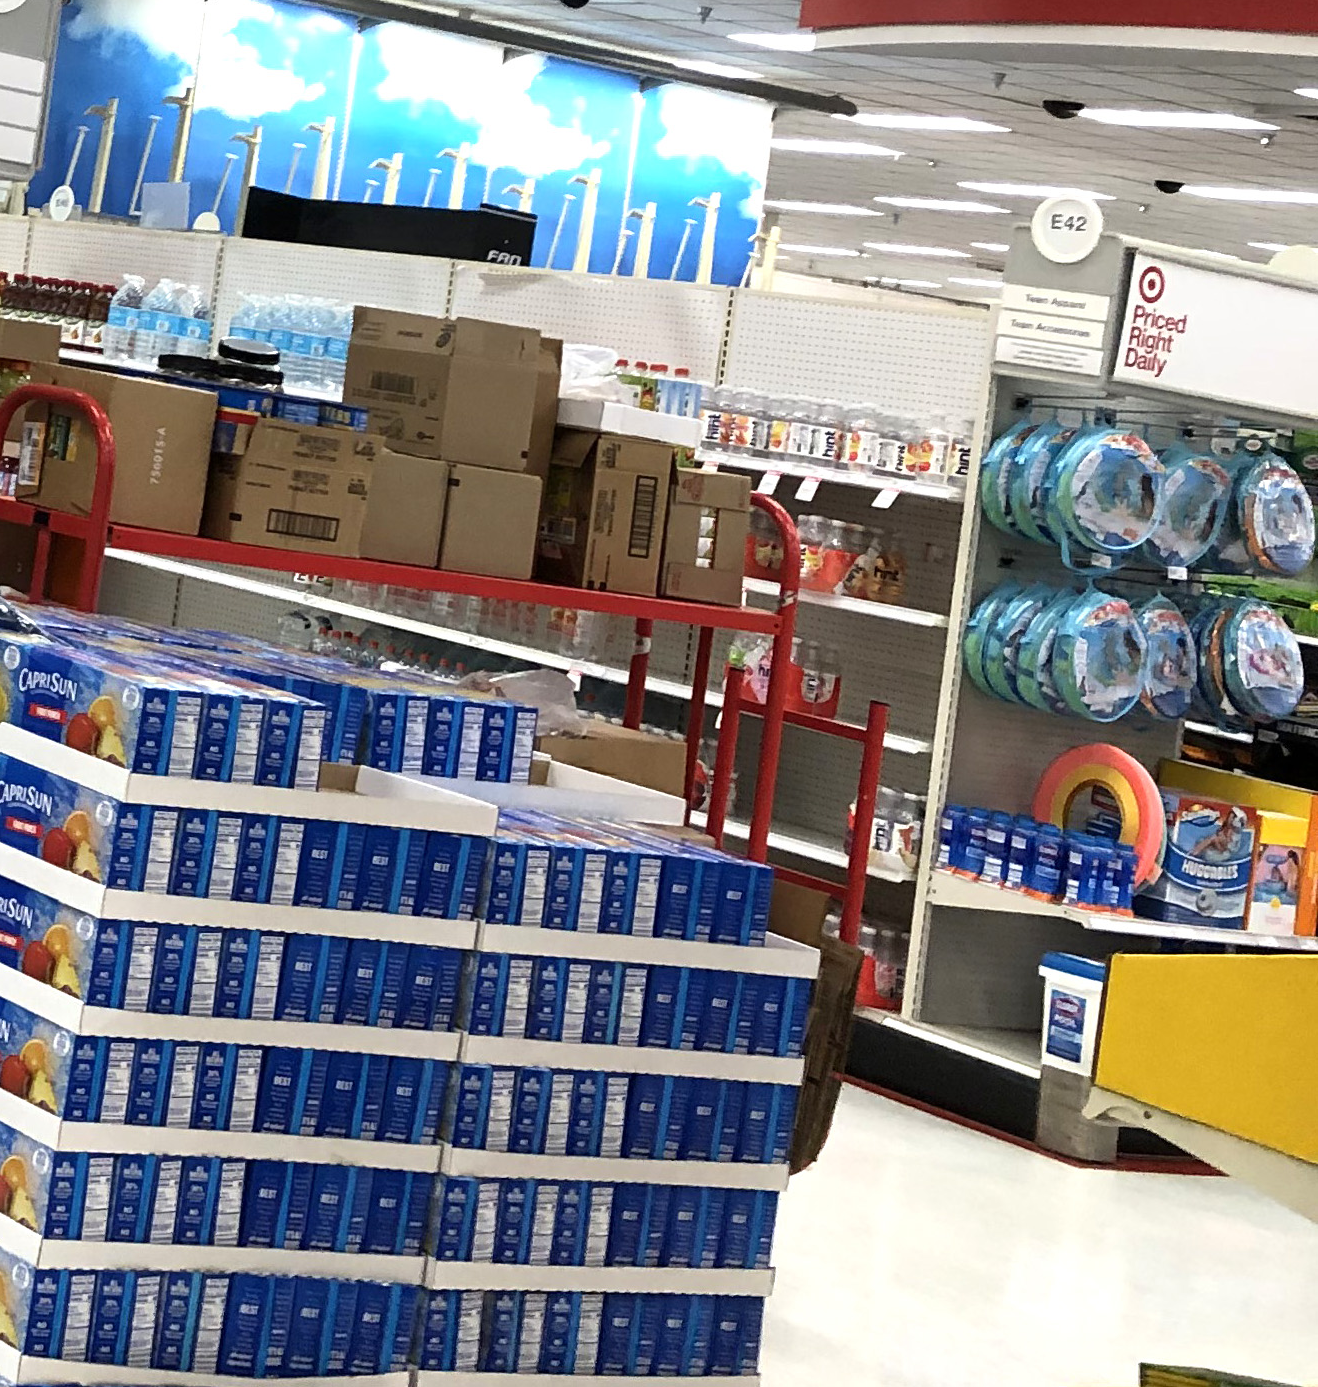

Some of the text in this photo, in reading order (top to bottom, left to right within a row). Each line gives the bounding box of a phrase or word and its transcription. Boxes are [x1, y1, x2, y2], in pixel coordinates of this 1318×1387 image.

[1051, 214, 1087, 232] E42
[1133, 305, 1187, 333] Priced
[1129, 327, 1174, 353] Right
[1124, 348, 1167, 377] Daily
[823, 431, 835, 457] hint
